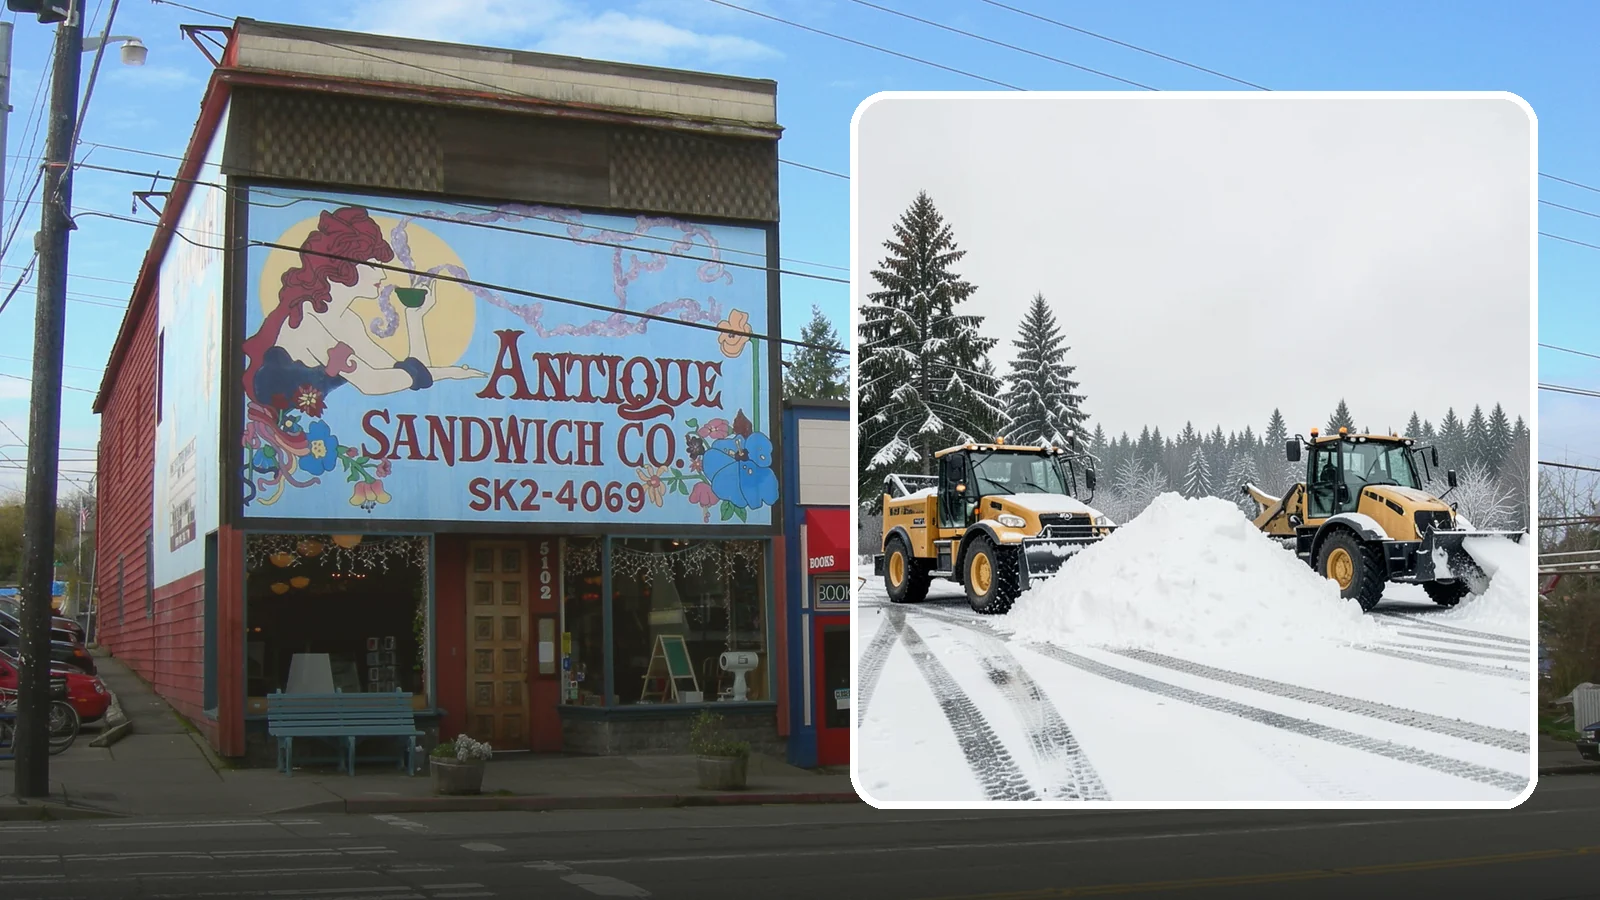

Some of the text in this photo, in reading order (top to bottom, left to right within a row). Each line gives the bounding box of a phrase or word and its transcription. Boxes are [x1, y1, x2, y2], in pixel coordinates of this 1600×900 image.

[475, 329, 724, 421] ANTIQUE
[361, 408, 685, 468] SANDWICH CO.
[468, 477, 646, 513] SK2-4069
[539, 542, 552, 600] 5102
[809, 555, 835, 569] BOOKS
